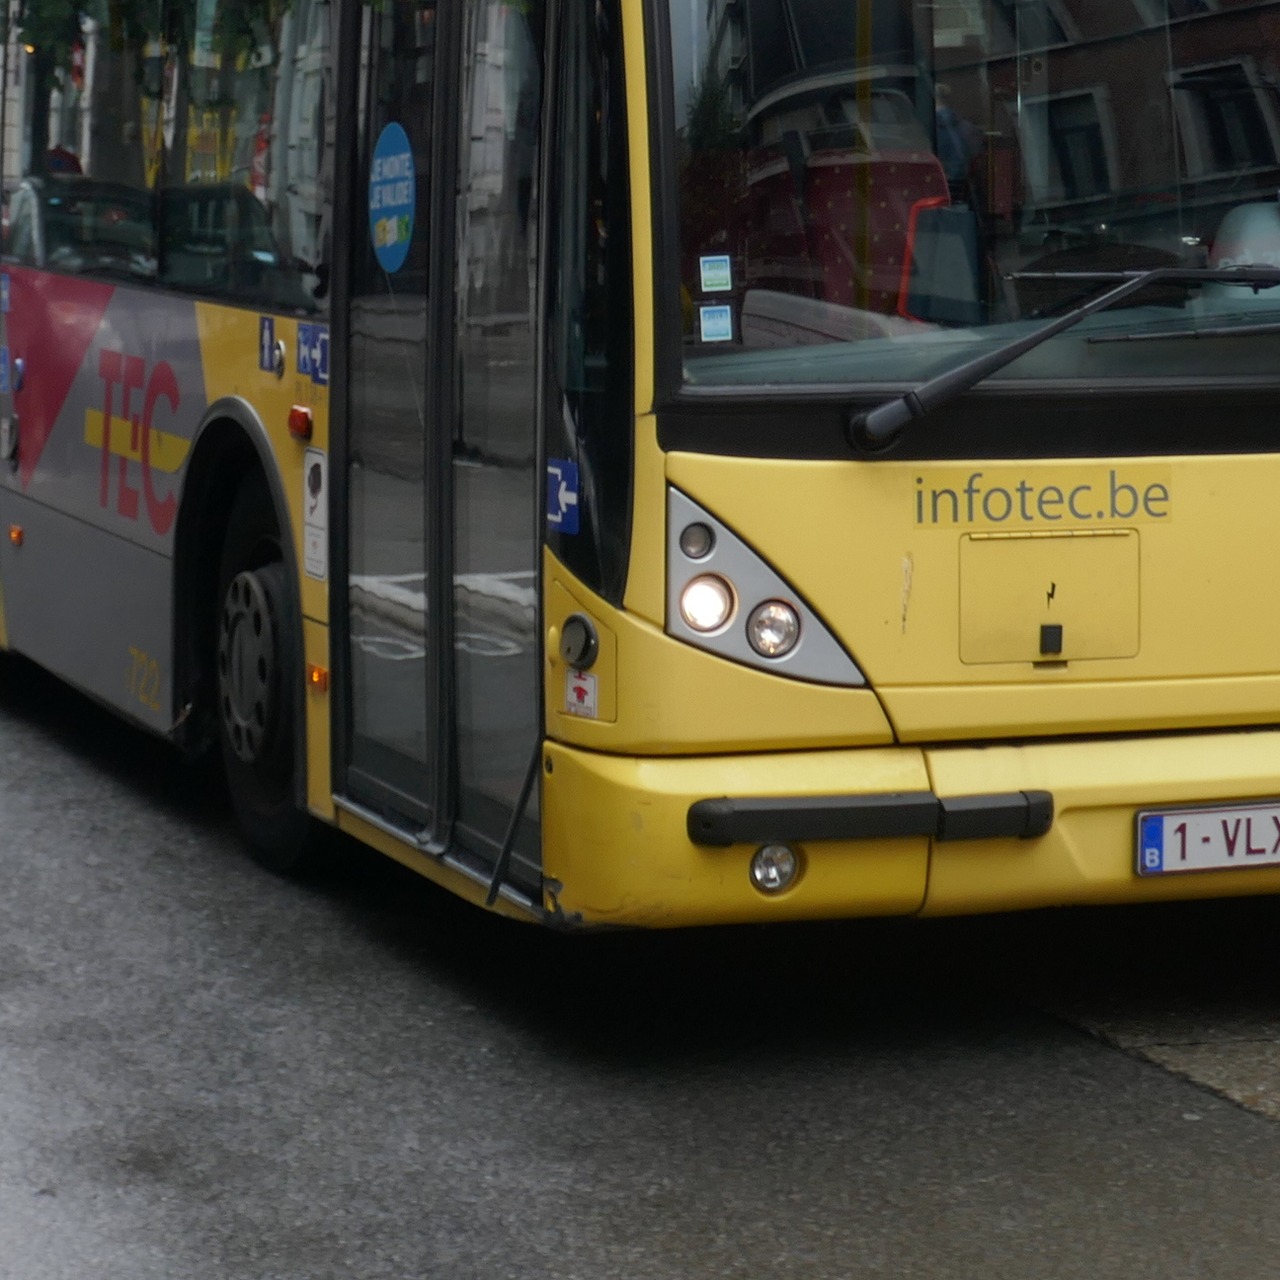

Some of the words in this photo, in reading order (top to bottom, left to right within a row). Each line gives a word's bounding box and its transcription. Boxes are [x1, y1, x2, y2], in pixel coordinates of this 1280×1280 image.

[98, 347, 181, 537] TEC
[915, 470, 1170, 524] infotec.be
[1145, 848, 1161, 868] B
